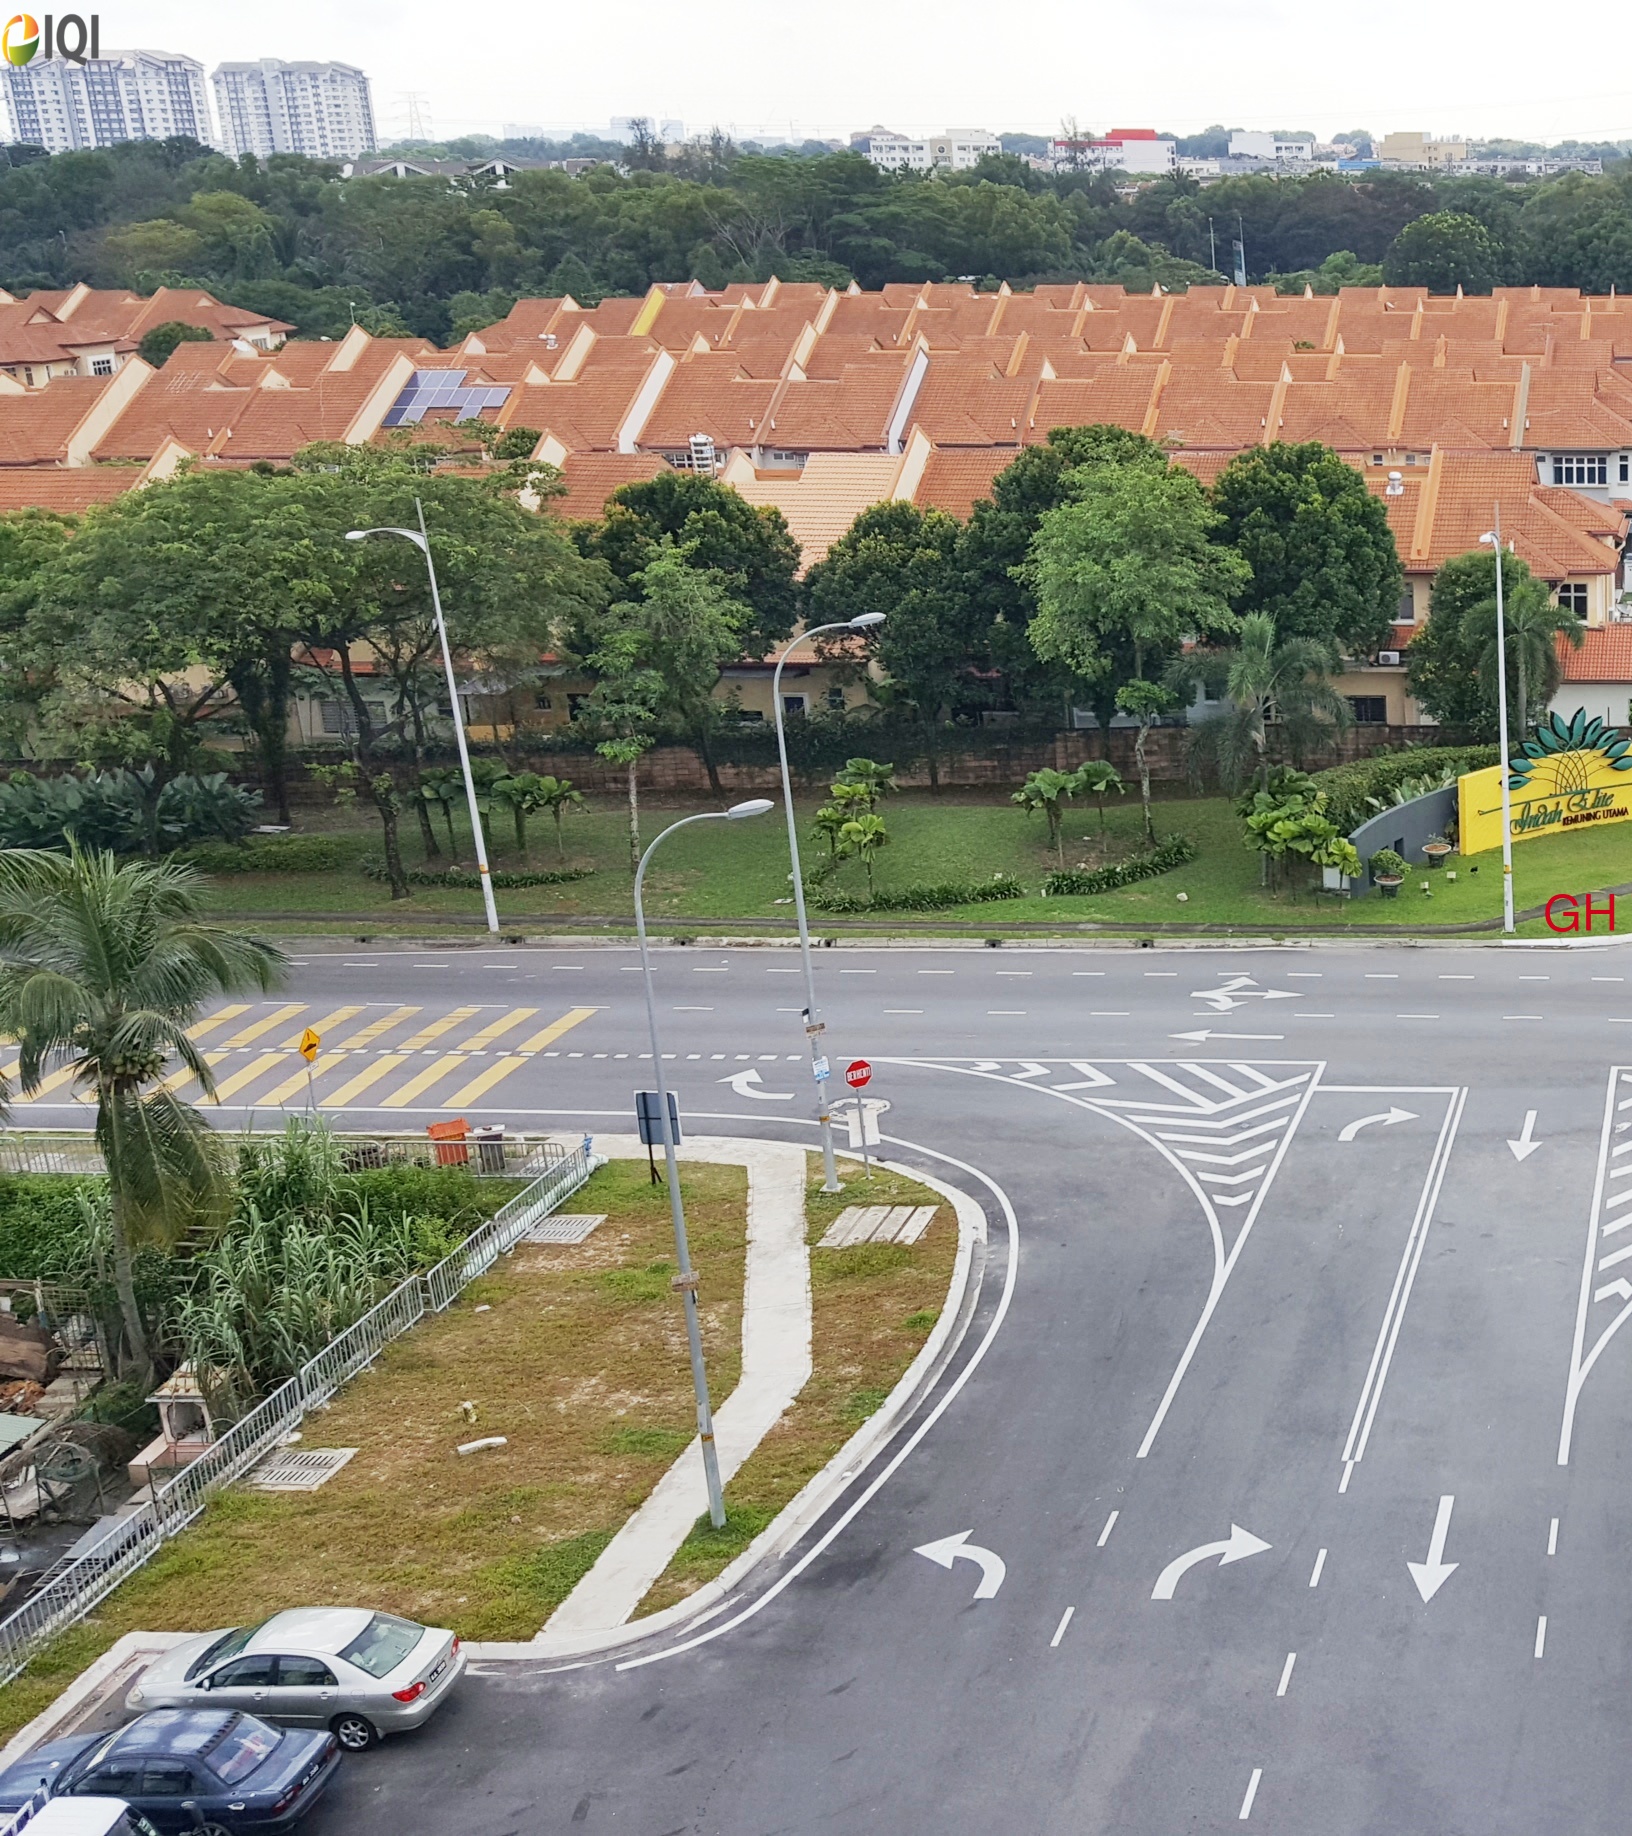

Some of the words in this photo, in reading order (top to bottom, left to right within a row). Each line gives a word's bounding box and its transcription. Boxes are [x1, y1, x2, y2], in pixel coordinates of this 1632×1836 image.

[1509, 801, 1564, 836] Indah
[1567, 788, 1615, 813] Elite
[1562, 810, 1601, 827] KEMUNING
[1602, 806, 1629, 820] UTAMA
